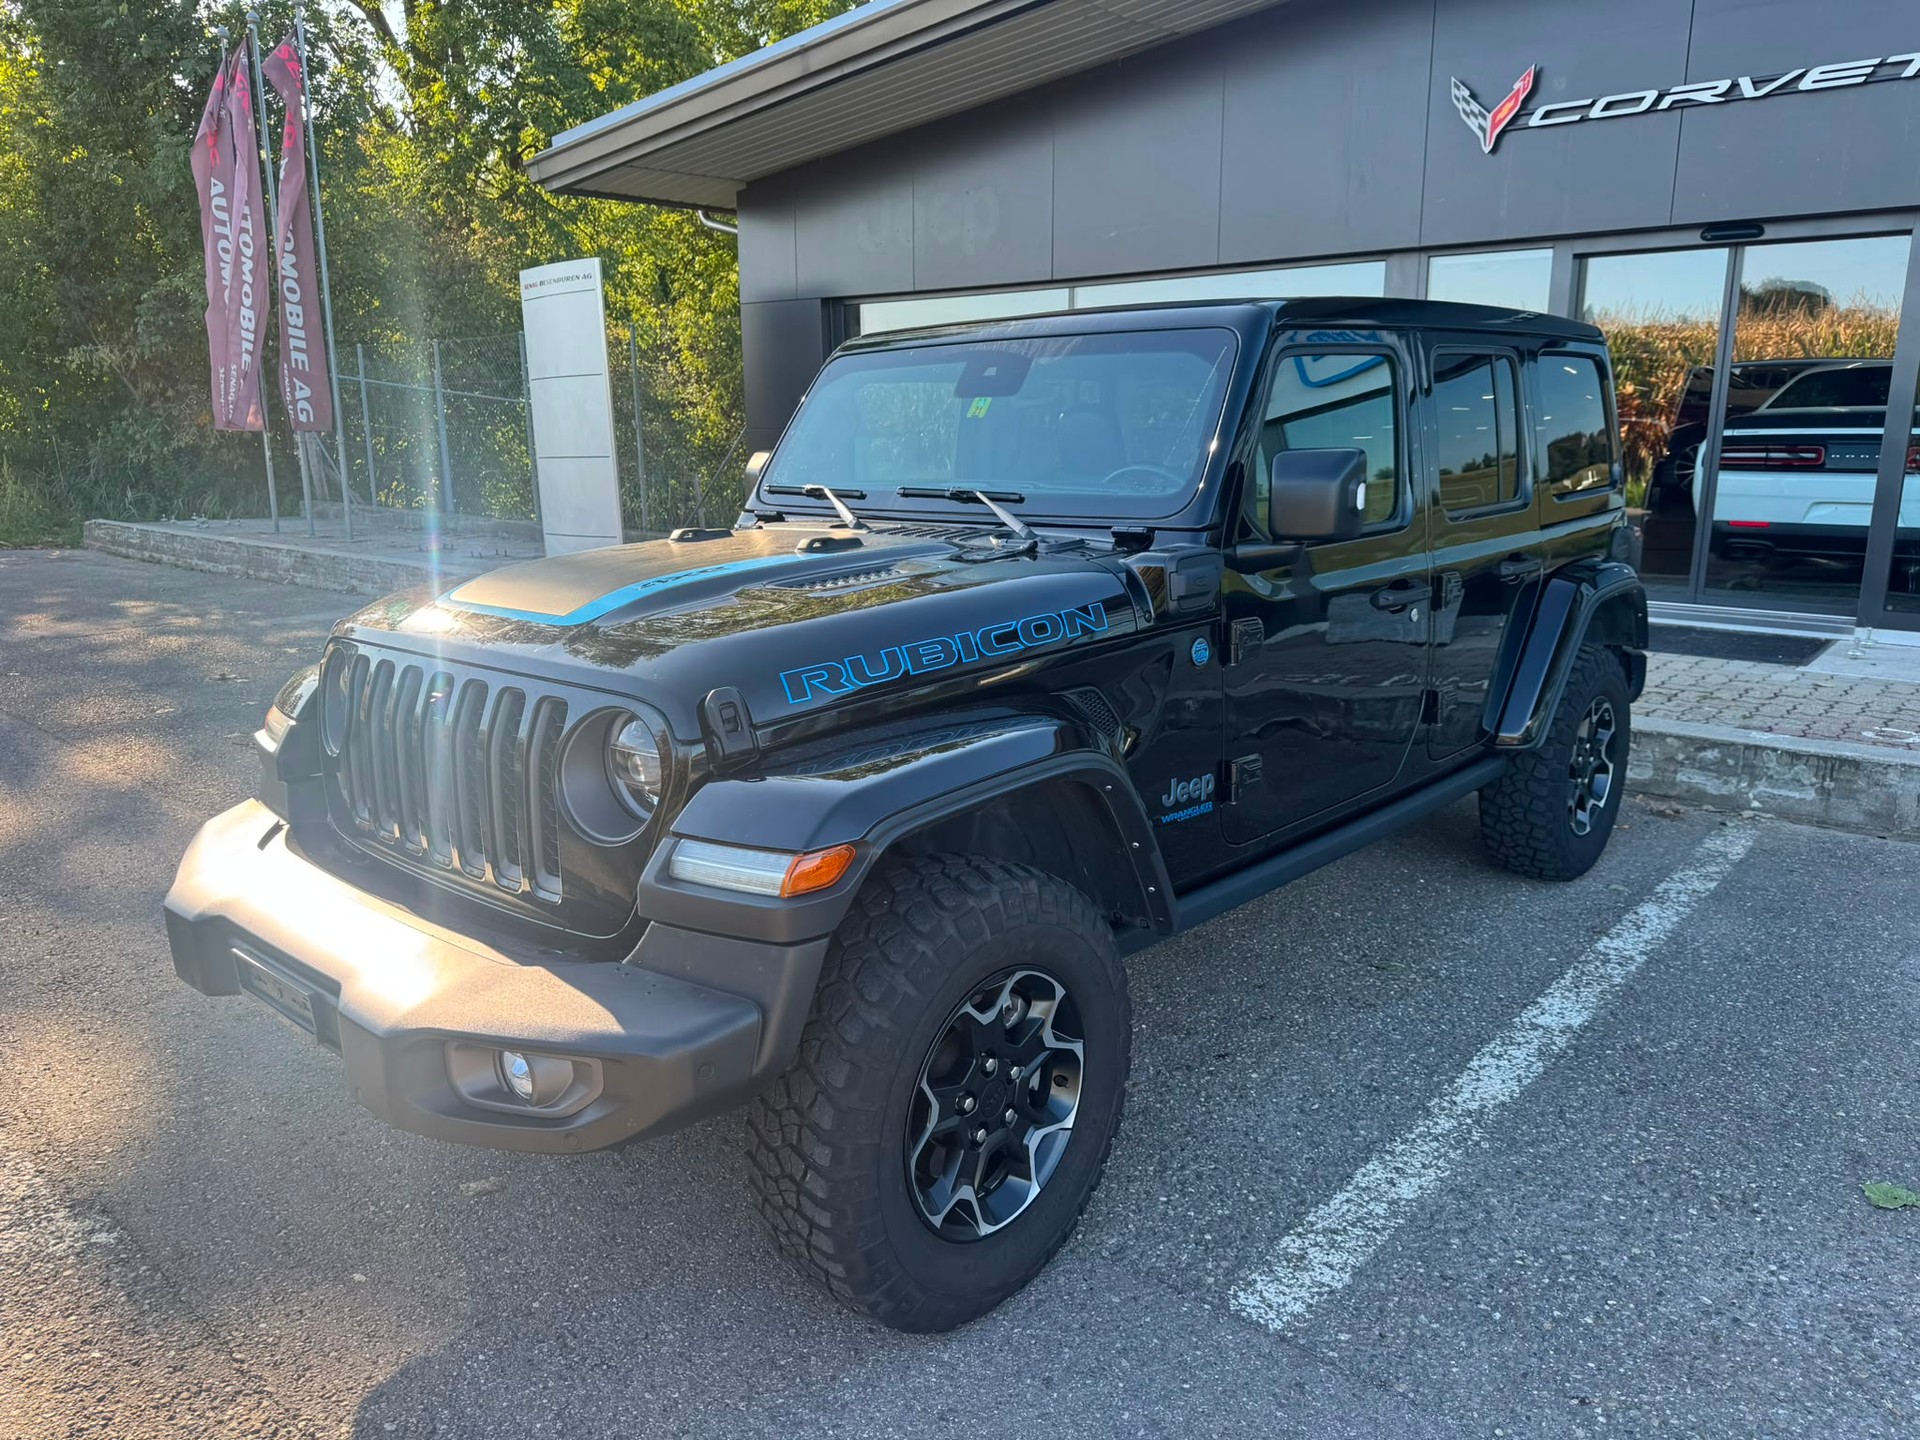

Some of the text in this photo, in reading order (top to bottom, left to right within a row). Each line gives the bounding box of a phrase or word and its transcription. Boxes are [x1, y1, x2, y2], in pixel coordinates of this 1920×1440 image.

[292, 377, 313, 423] AG
[778, 602, 1109, 704] RUBICON
[1161, 773, 1215, 807] Jeep
[1161, 801, 1213, 824] WRANGLER
